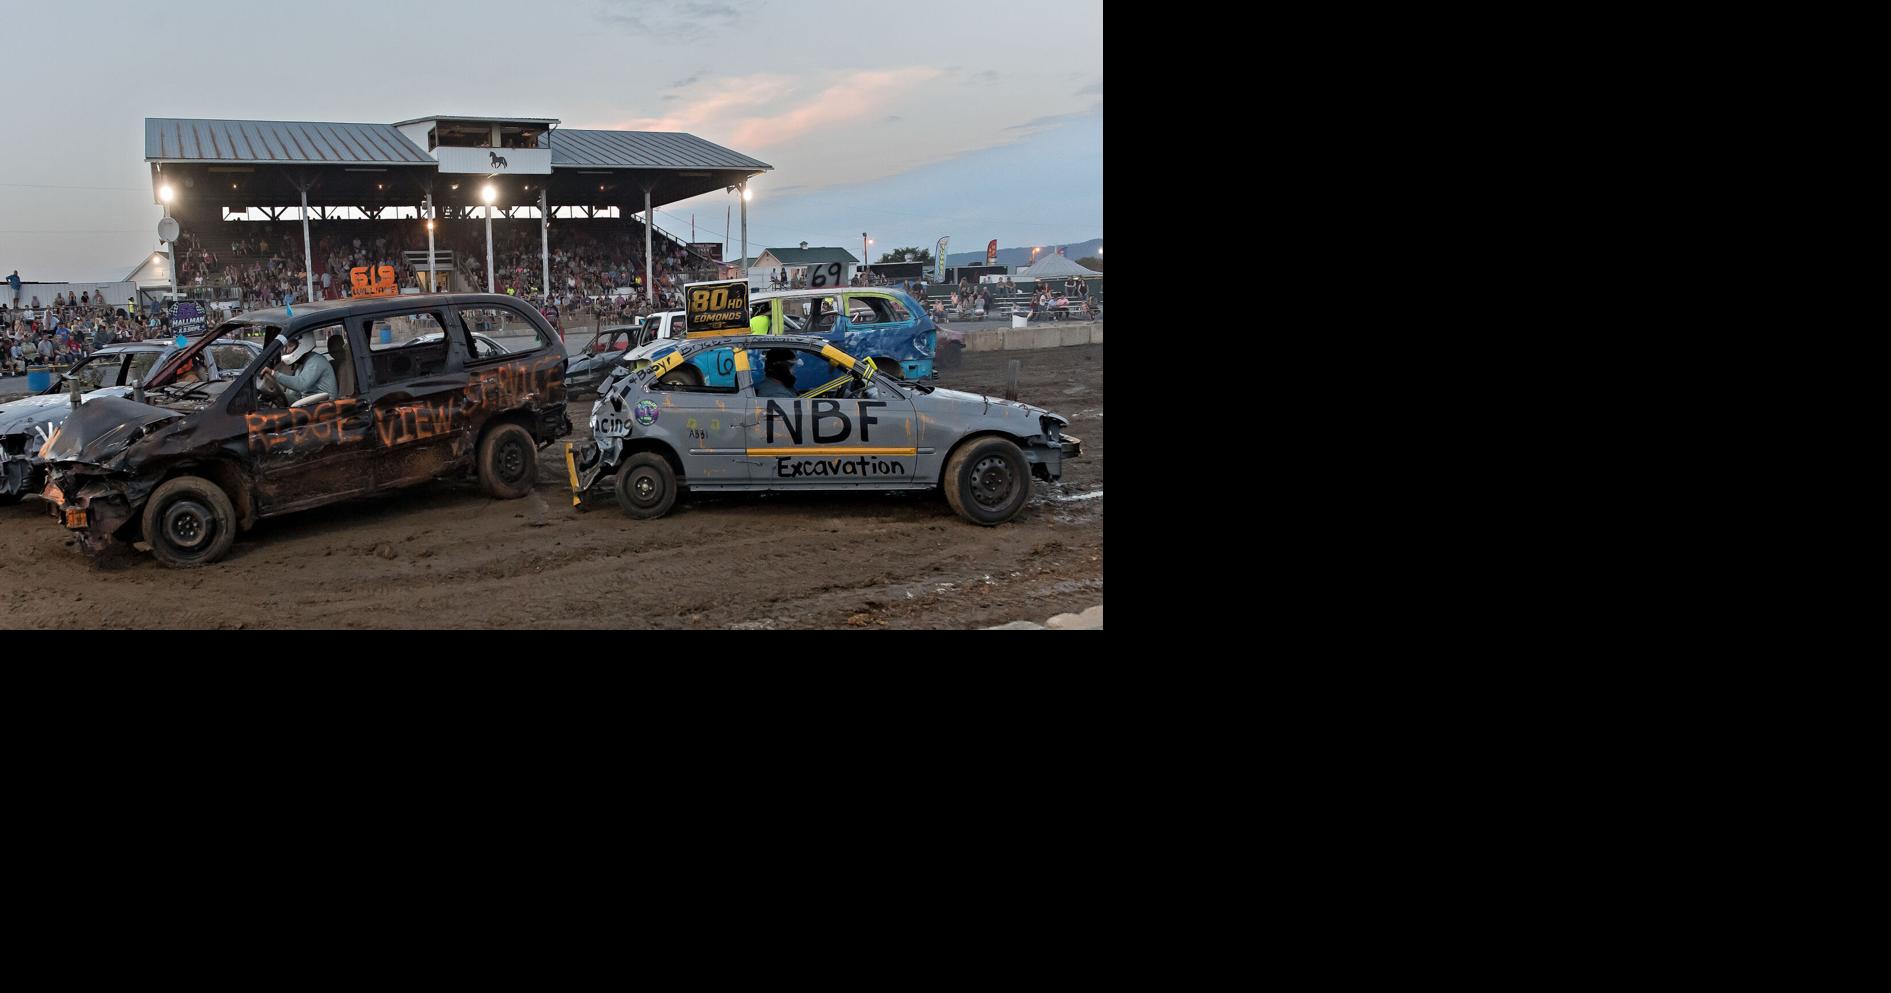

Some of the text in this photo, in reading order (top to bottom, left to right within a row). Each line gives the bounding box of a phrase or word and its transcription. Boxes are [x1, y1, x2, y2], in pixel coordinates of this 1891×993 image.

[350, 265, 395, 288] 619
[811, 262, 842, 288] 69
[692, 288, 743, 312] 80 HD
[172, 316, 206, 328] HALLMAN
[694, 312, 742, 323] EDMONDS
[717, 351, 734, 376] 6
[245, 399, 364, 452] RIDGE
[374, 396, 455, 448] VIEW
[766, 400, 887, 445] NBF
[776, 456, 905, 478] Excavation
